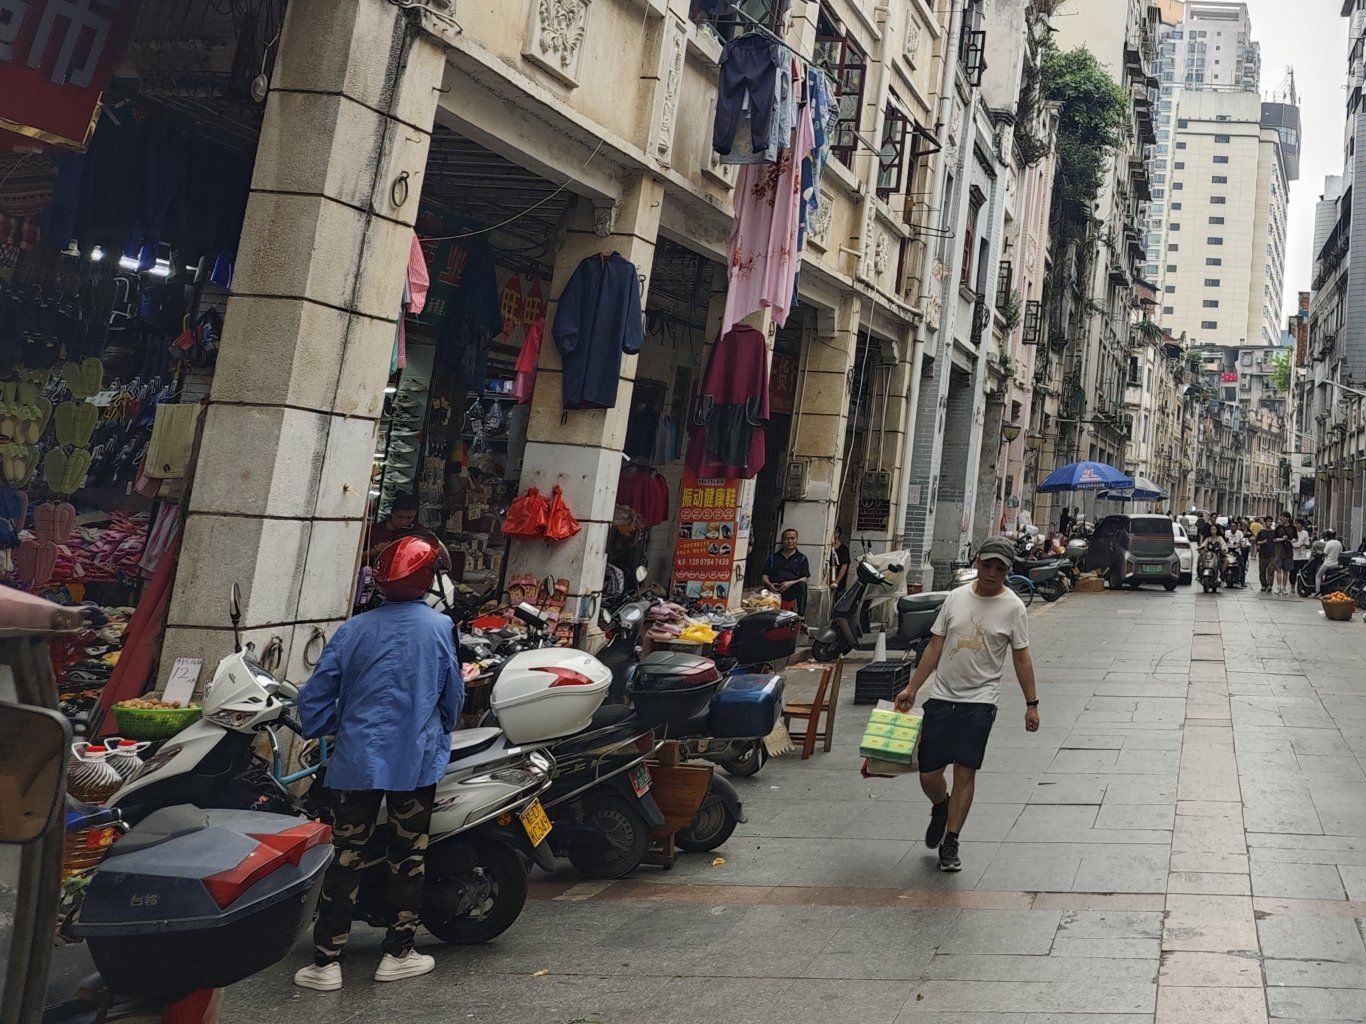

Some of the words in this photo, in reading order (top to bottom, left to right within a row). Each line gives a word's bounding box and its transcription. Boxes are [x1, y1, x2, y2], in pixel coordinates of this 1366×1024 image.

[681, 487, 736, 507] 振动健康鞋
